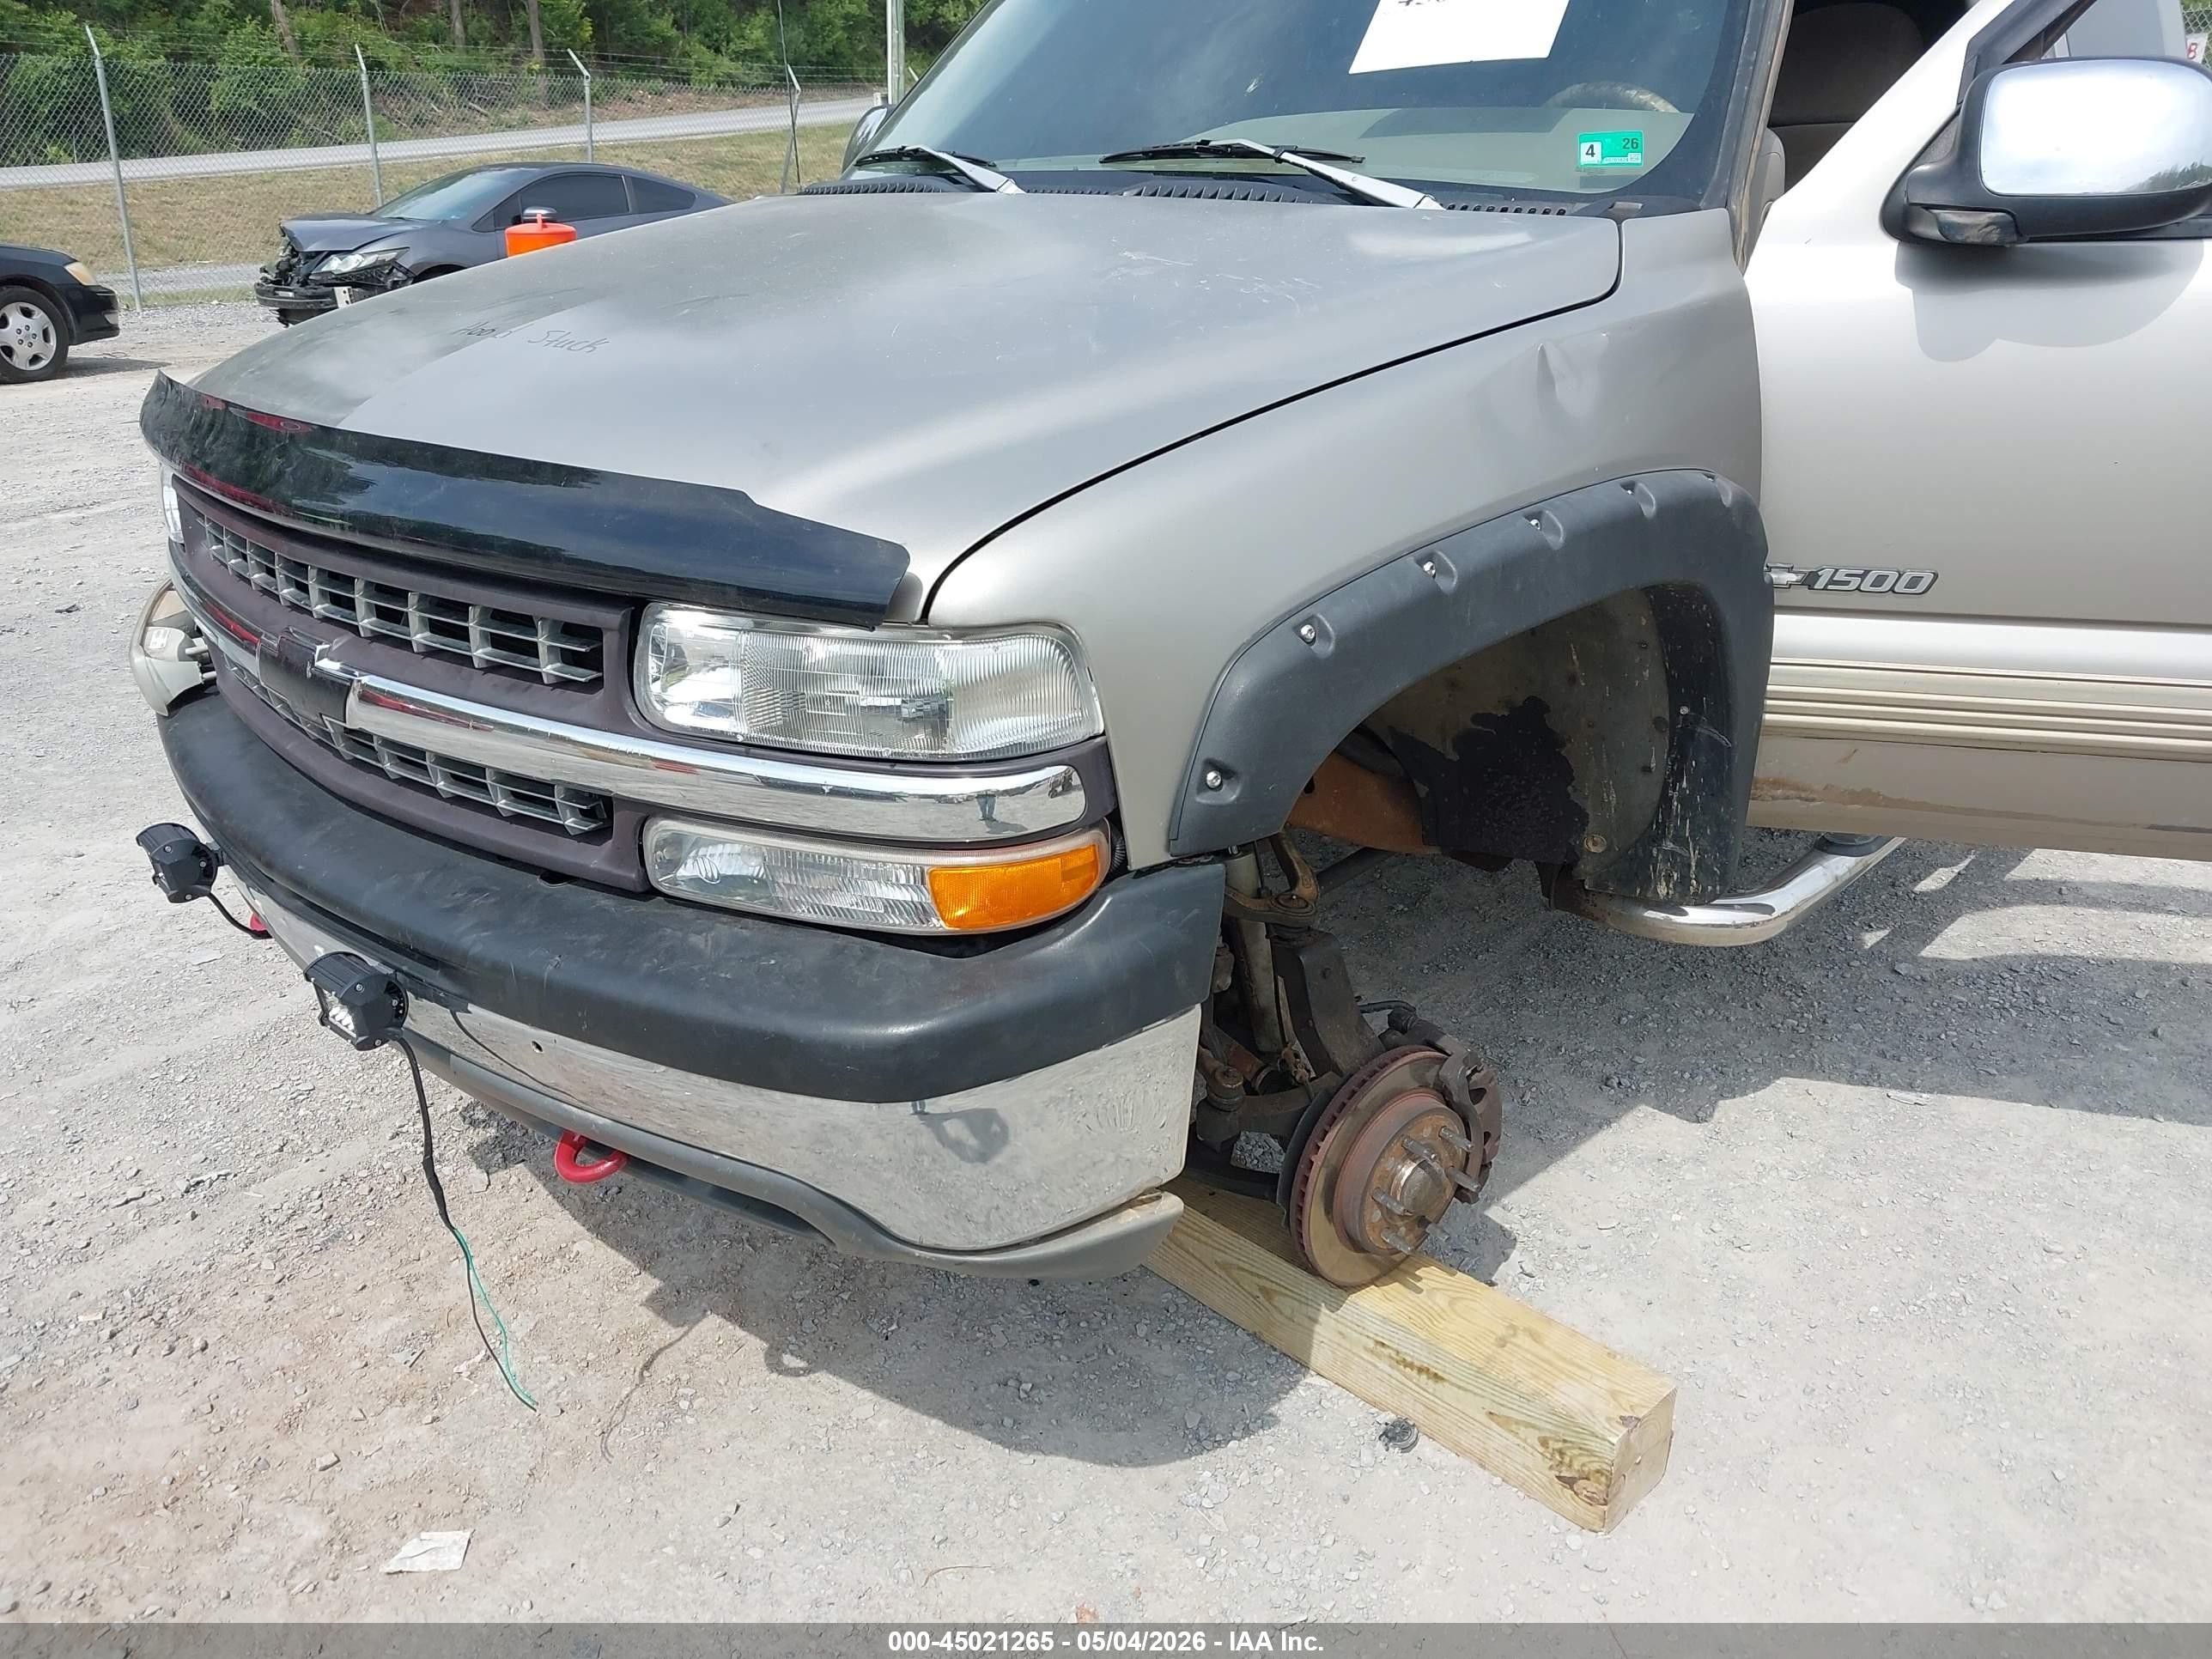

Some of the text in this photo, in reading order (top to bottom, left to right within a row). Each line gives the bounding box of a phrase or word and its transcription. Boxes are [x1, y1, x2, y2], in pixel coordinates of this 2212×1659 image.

[1585, 143, 1596, 158] 4
[1622, 137, 1639, 149] 26
[1812, 567, 1936, 594] 1500
